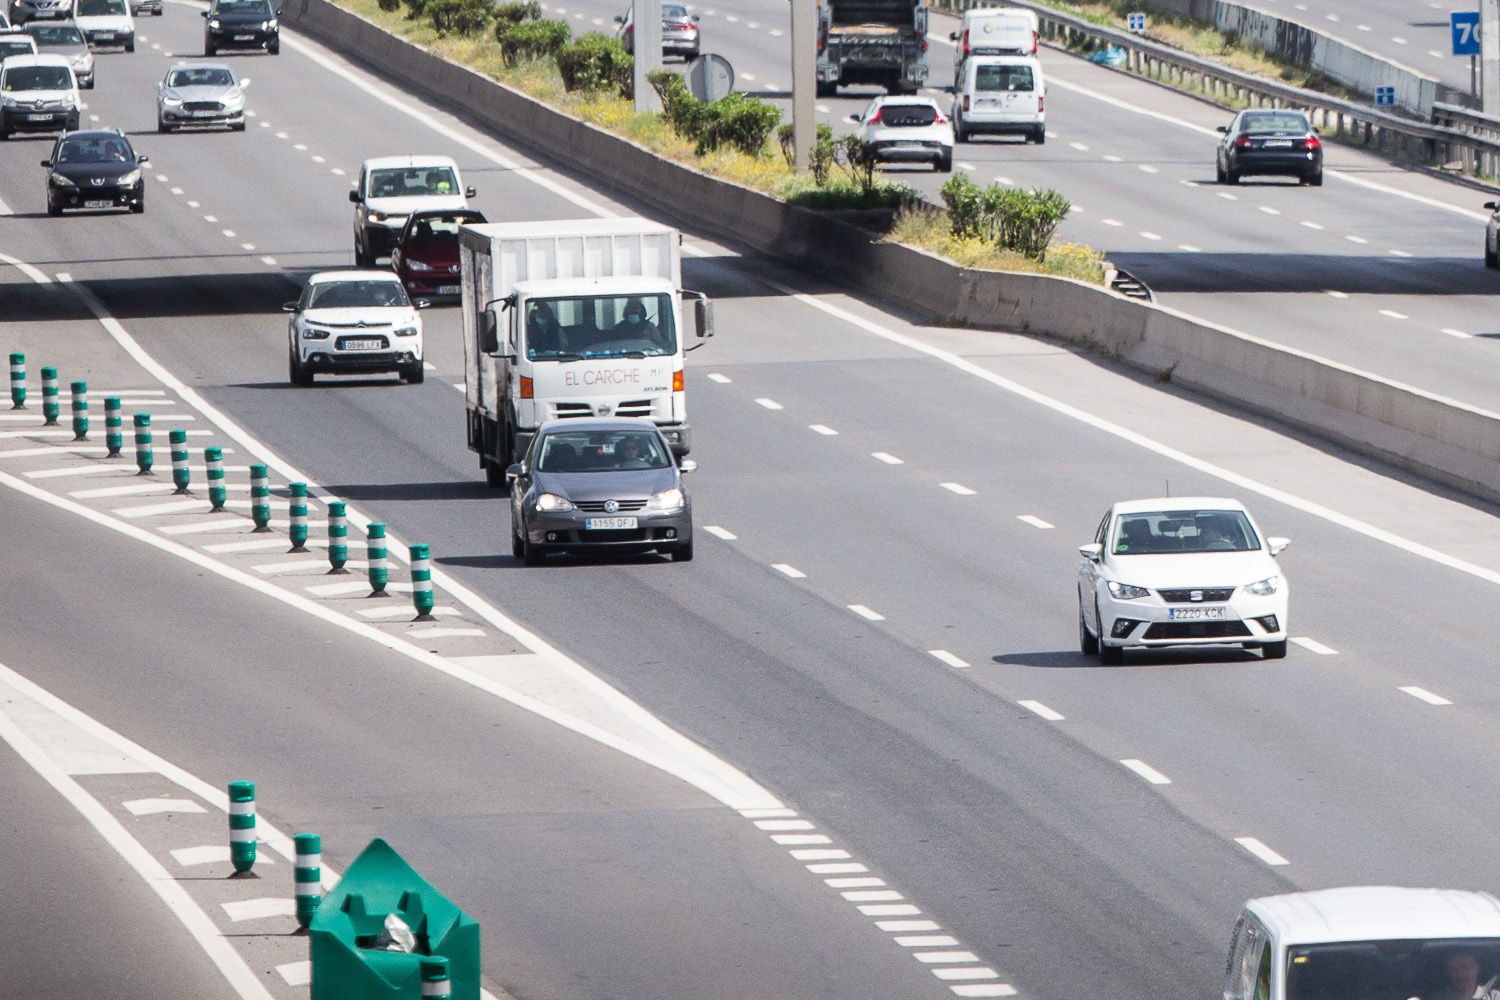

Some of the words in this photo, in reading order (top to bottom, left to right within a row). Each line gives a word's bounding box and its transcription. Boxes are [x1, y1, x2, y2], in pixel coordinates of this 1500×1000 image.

[565, 371, 580, 386] EL
[583, 368, 640, 386] CARCHE
[1175, 608, 1201, 619] 2220
